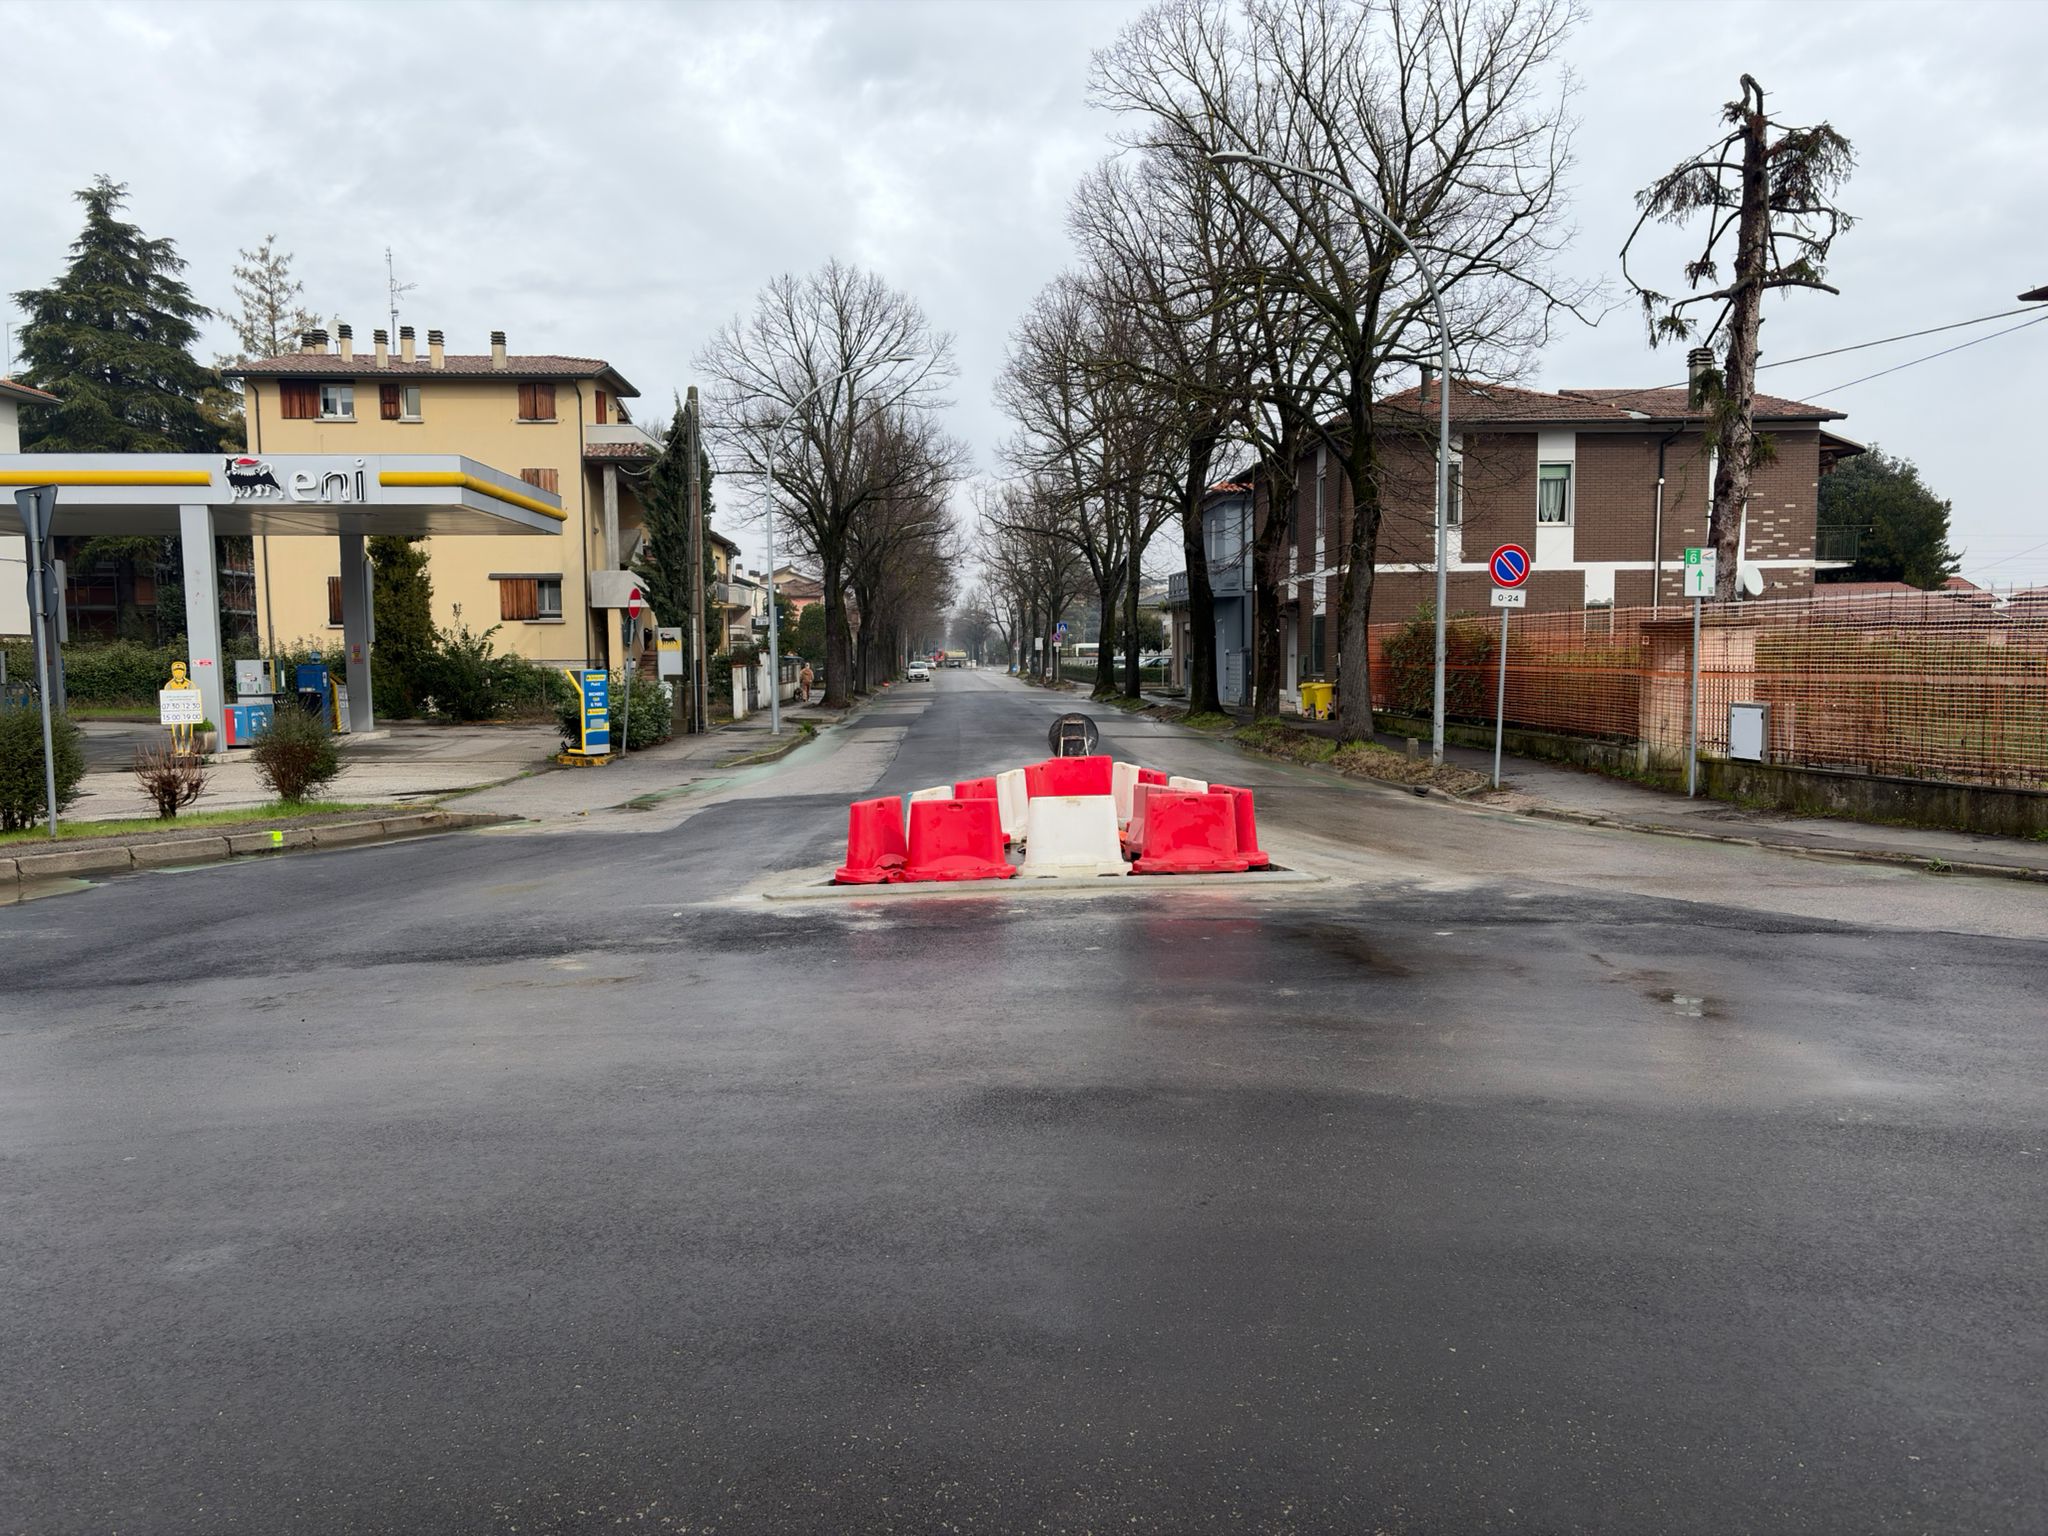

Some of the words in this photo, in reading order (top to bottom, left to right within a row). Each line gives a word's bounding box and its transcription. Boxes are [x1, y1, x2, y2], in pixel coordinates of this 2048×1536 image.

[288, 458, 367, 502] eni
[1690, 553, 1698, 564] 6
[1497, 593, 1519, 602] 0-24
